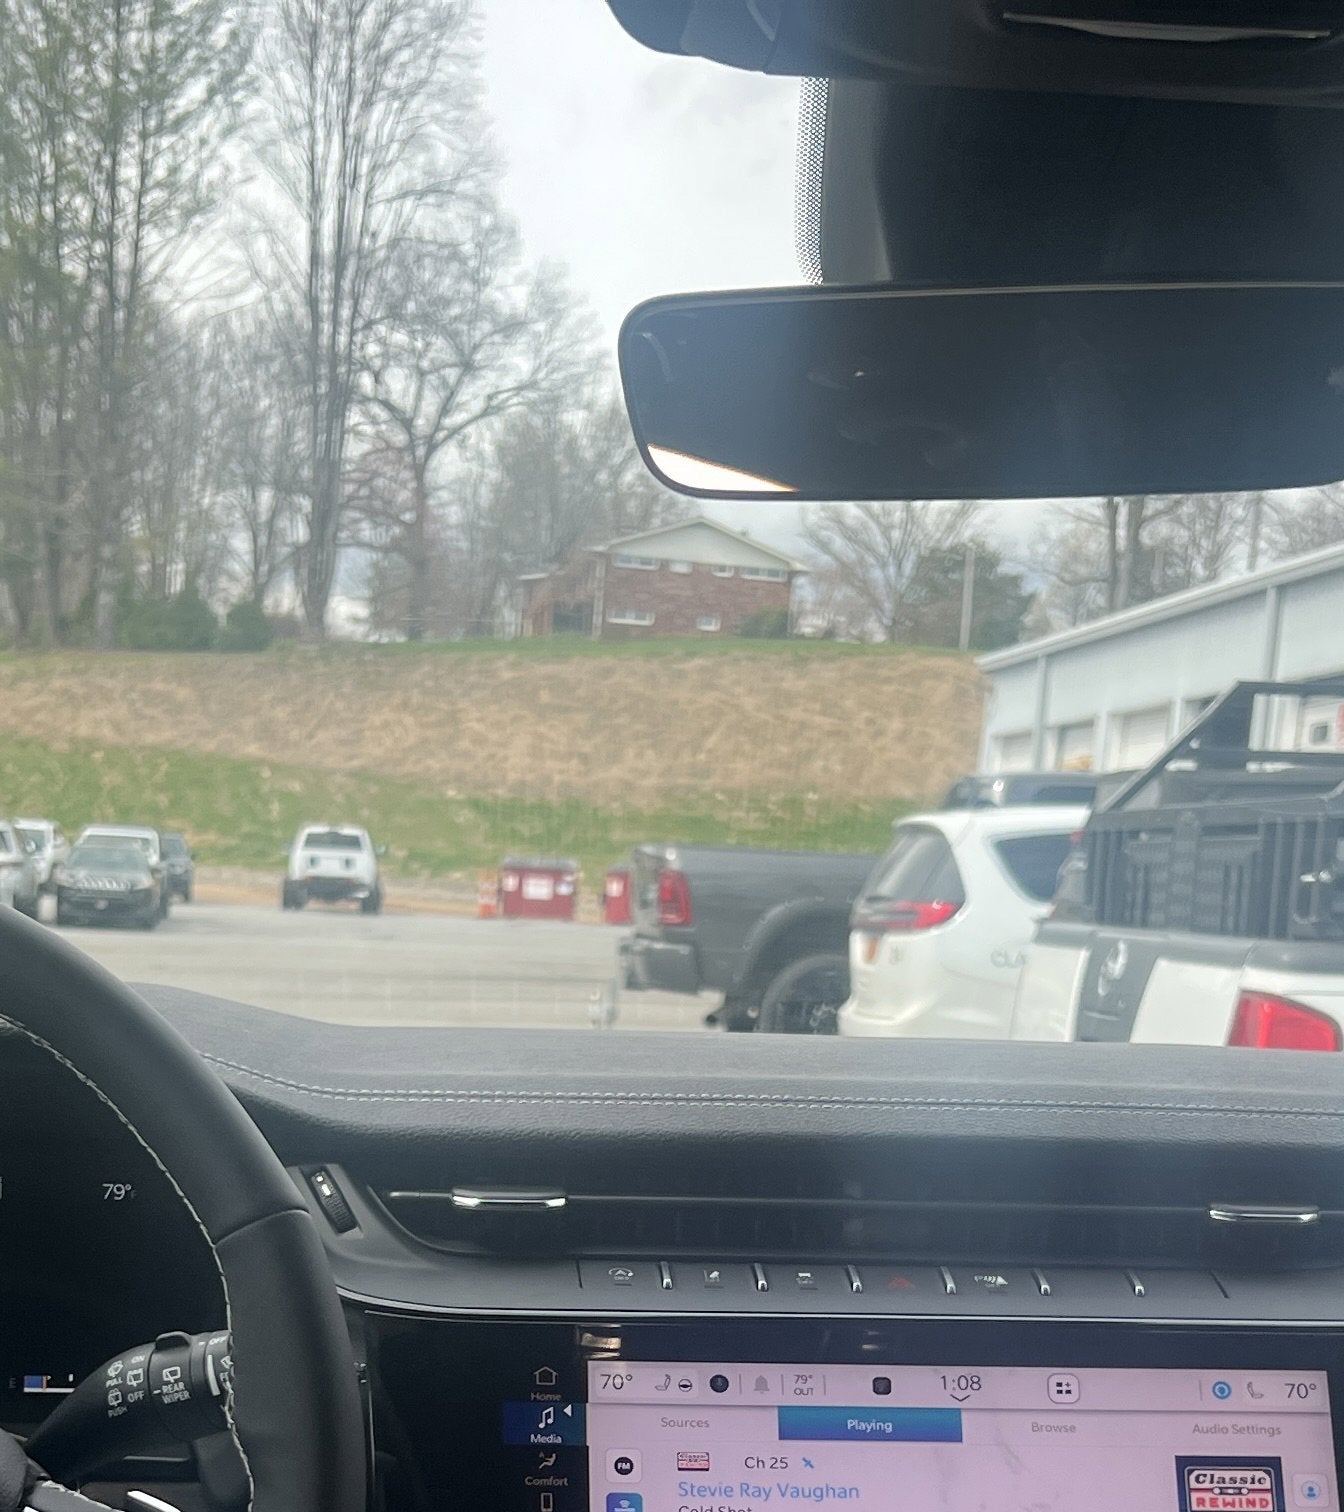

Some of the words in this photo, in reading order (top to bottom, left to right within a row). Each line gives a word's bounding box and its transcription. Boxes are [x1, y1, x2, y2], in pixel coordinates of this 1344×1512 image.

[600, 1373, 633, 1391] 70°
[793, 1373, 813, 1385] 79°
[939, 1374, 982, 1392] 1:08
[162, 1381, 185, 1395] REAR
[793, 1387, 815, 1396] OUT
[1284, 1382, 1317, 1399] 70°
[127, 1390, 145, 1403] OFF
[161, 1390, 192, 1405] WIPER
[530, 1392, 562, 1402] Home
[660, 1417, 710, 1428] Sources
[846, 1419, 893, 1434] Playing
[1031, 1422, 1077, 1434] Browse
[1192, 1423, 1230, 1436] Audio
[1231, 1424, 1282, 1437] Settings
[530, 1433, 562, 1444] Media
[617, 1462, 631, 1470] FM
[744, 1456, 765, 1470] Ch
[768, 1456, 789, 1470] 25
[524, 1475, 568, 1487] Comfort
[1194, 1473, 1267, 1485] Classic
[678, 1482, 736, 1499] Stevie
[739, 1482, 772, 1502] Ray
[777, 1482, 861, 1503] Vaughan
[1196, 1497, 1269, 1509] REWIND
